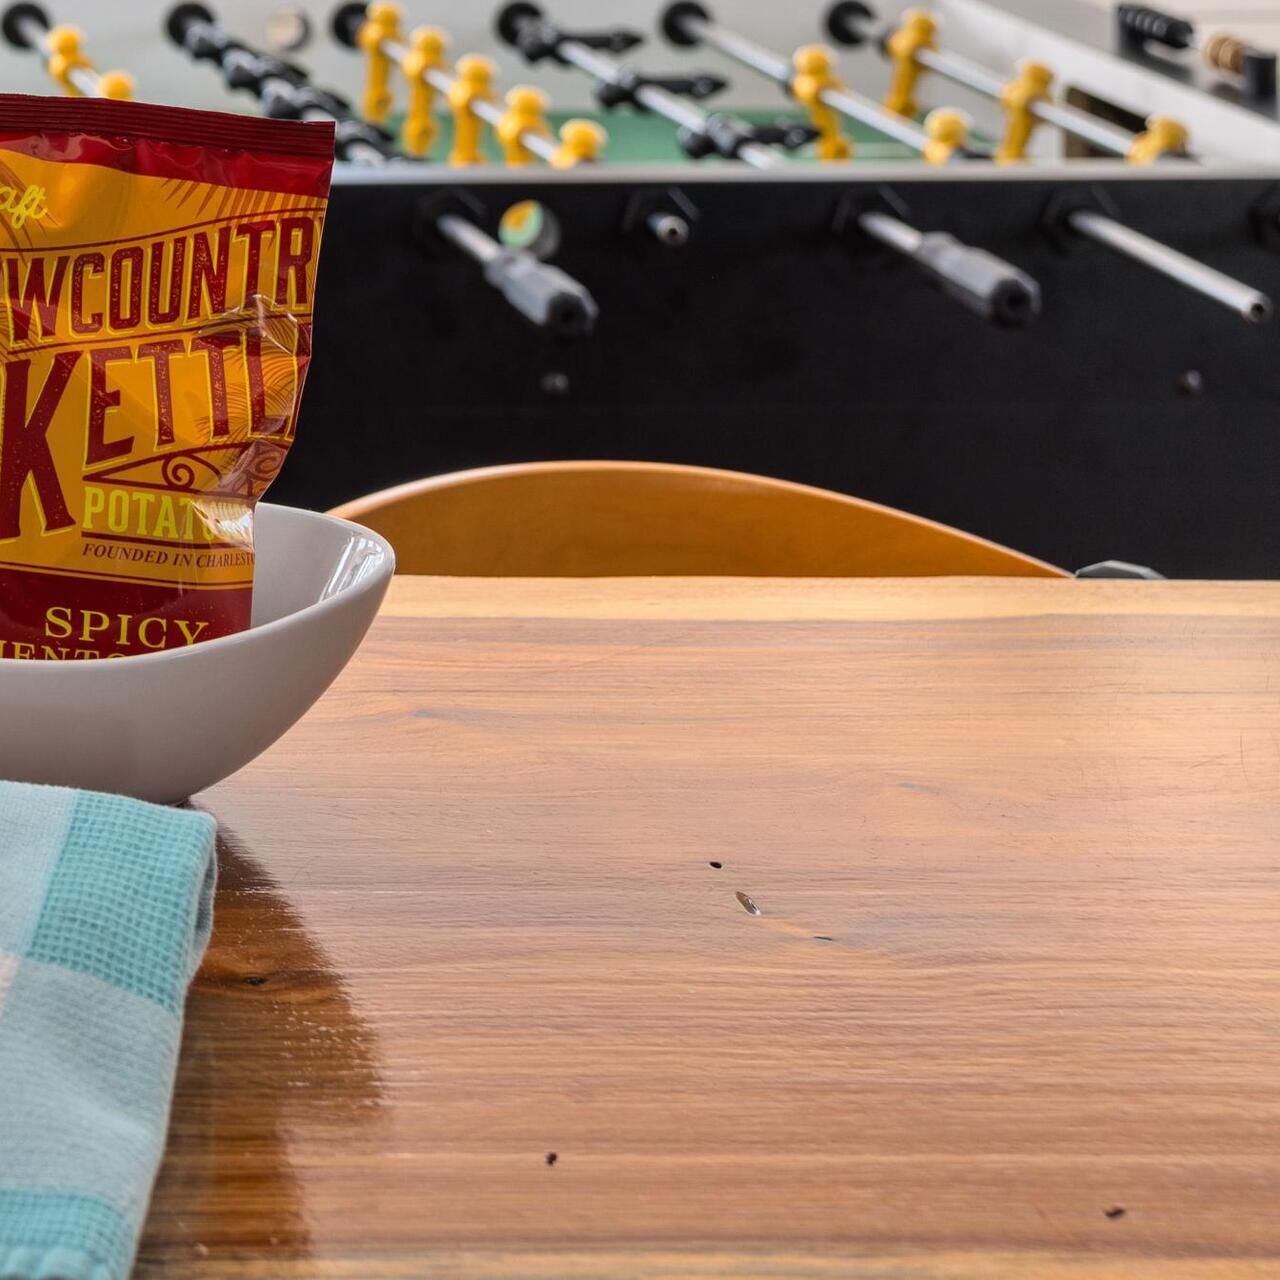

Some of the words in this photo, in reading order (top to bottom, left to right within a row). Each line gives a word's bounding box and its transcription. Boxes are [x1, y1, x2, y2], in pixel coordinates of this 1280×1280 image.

[82, 542, 169, 565] FOUNDED
[172, 552, 192, 567] IN
[44, 606, 209, 650] SPICY
